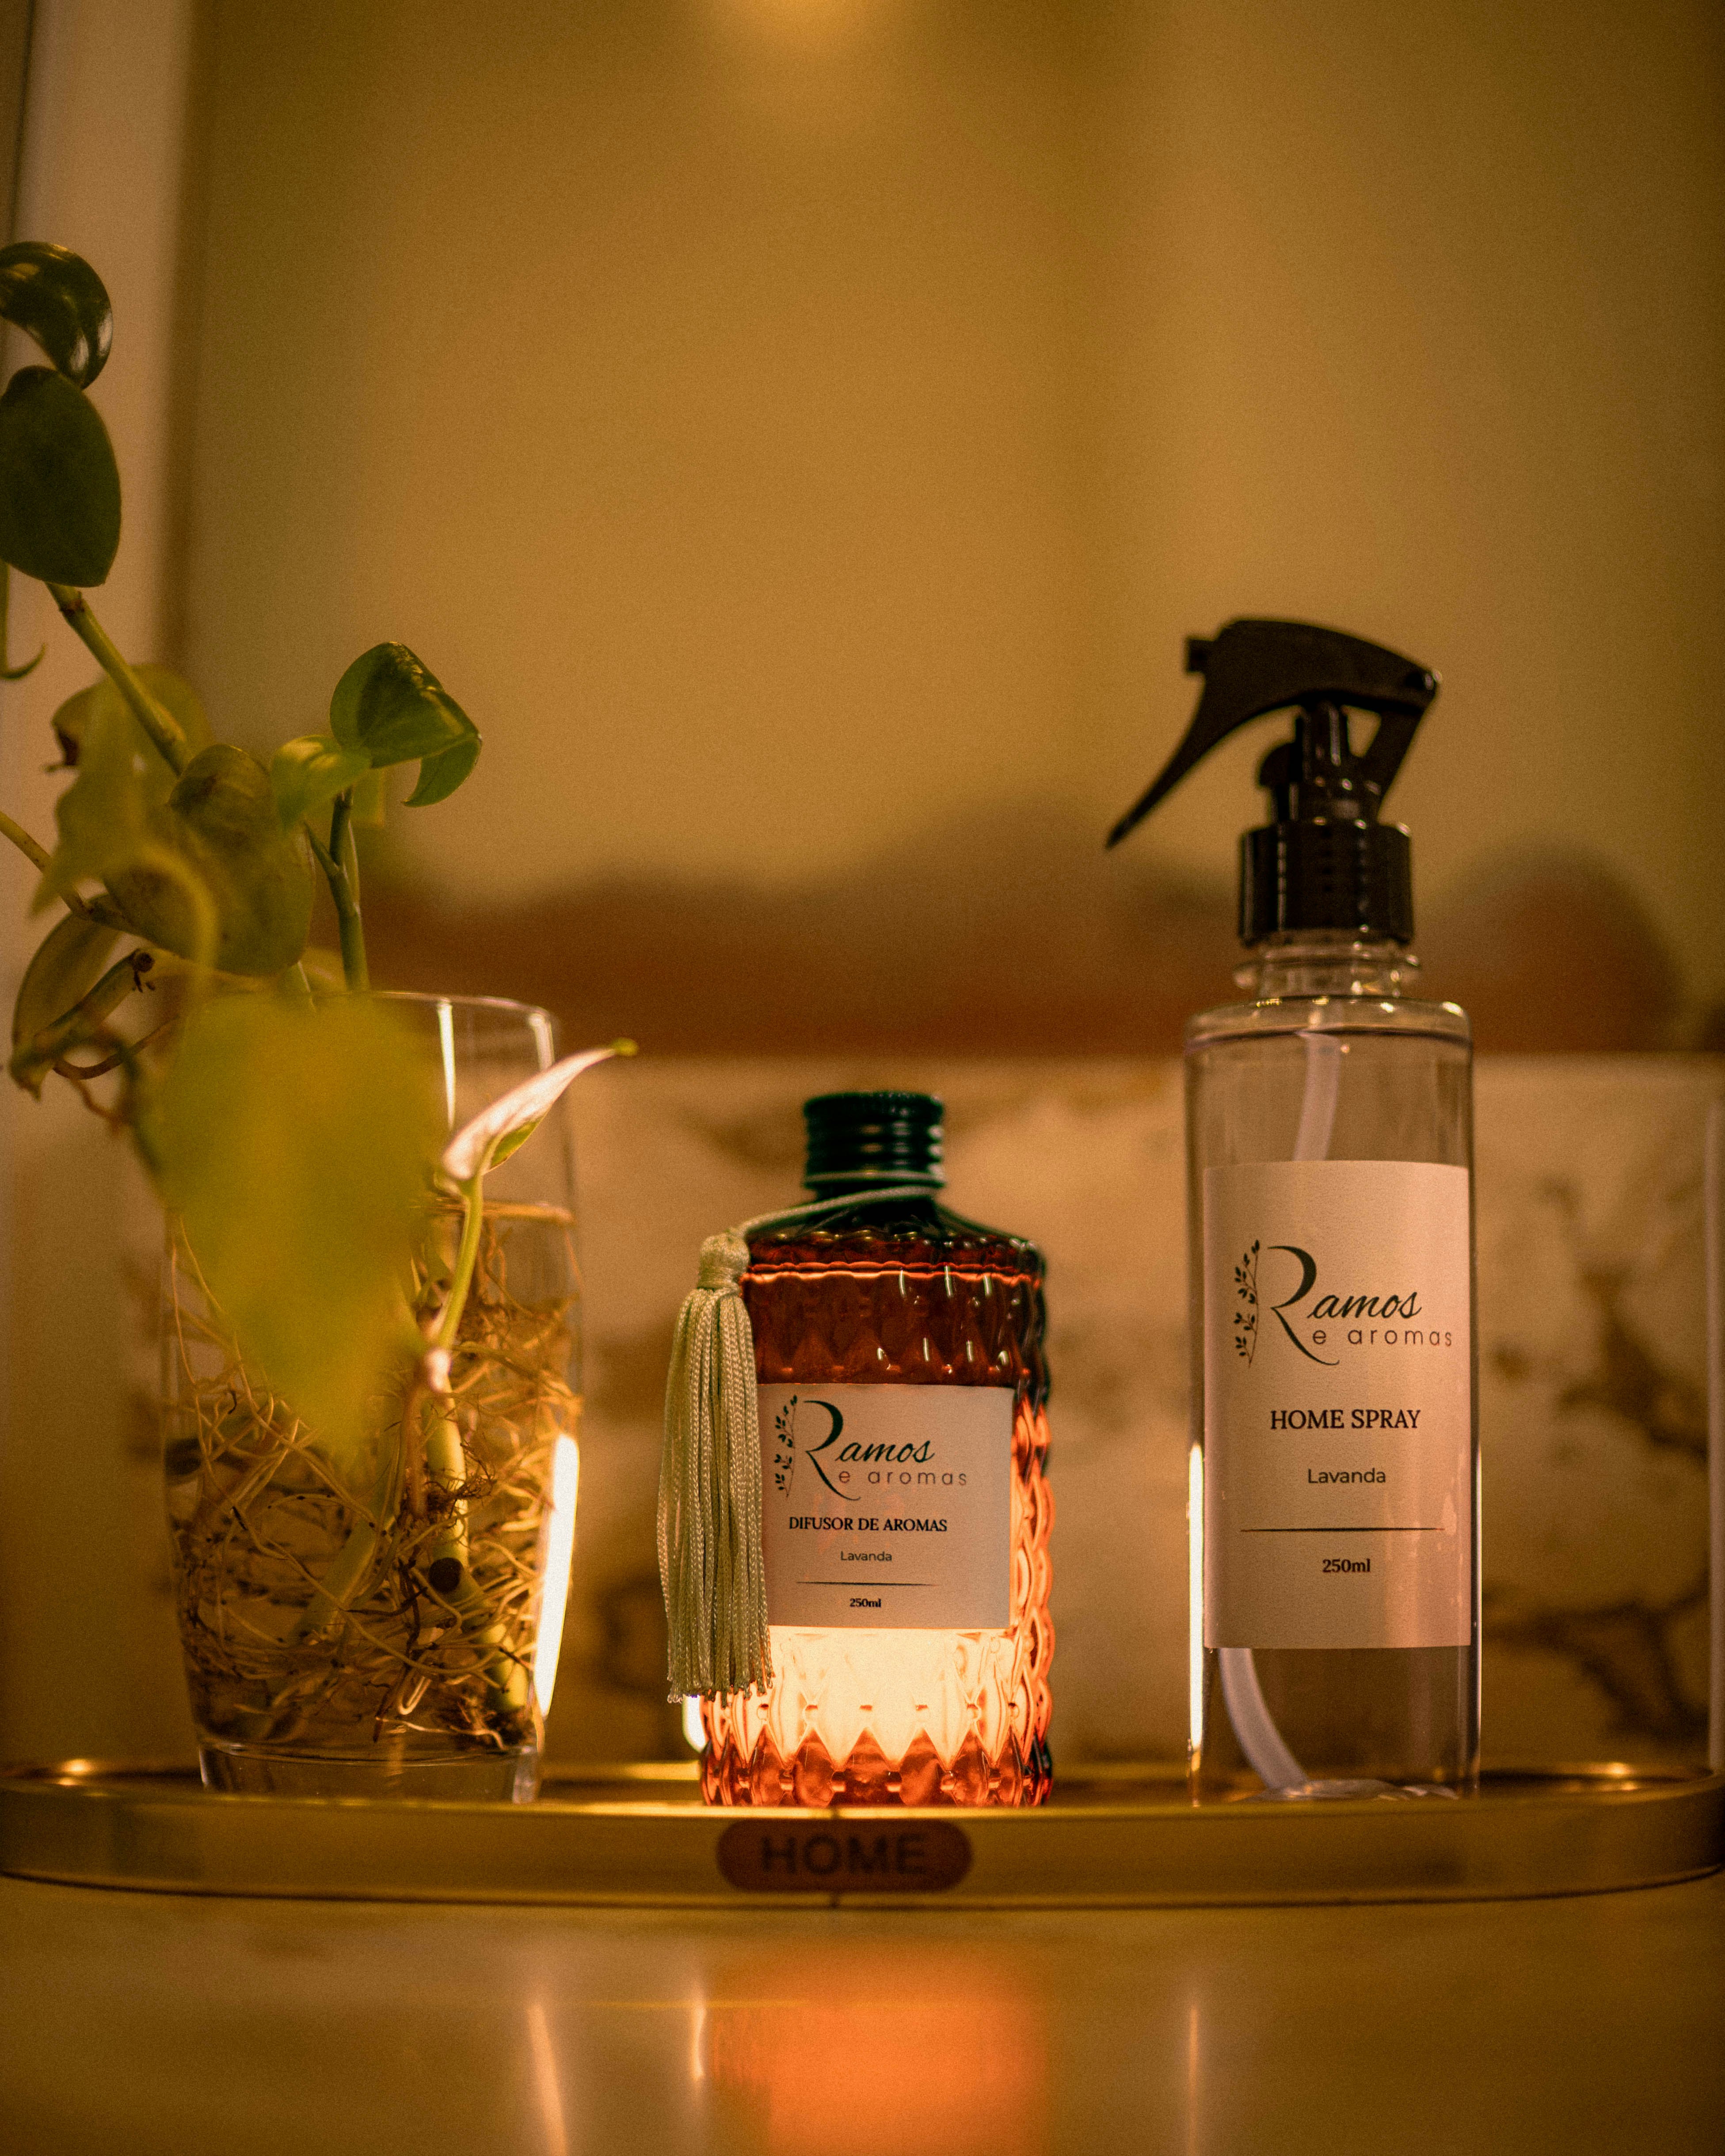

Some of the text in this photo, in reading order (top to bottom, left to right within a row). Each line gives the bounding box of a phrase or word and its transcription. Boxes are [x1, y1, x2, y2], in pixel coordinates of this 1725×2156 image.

[1267, 1245, 1422, 1366] Ramos
[1312, 1328, 1452, 1347] e aromas
[1270, 1409, 1421, 1430] HOME SPRAY
[803, 1400, 936, 1501] Ramos
[839, 1470, 967, 1486] e aromas
[1307, 1468, 1386, 1484] Lavanda
[788, 1516, 948, 1532] DIFUSOR DE AROMAS
[840, 1551, 893, 1562] Lavanda
[1322, 1558, 1371, 1574] 250ml
[849, 1598, 882, 1608] 250ml
[760, 1833, 928, 1876] HOME
